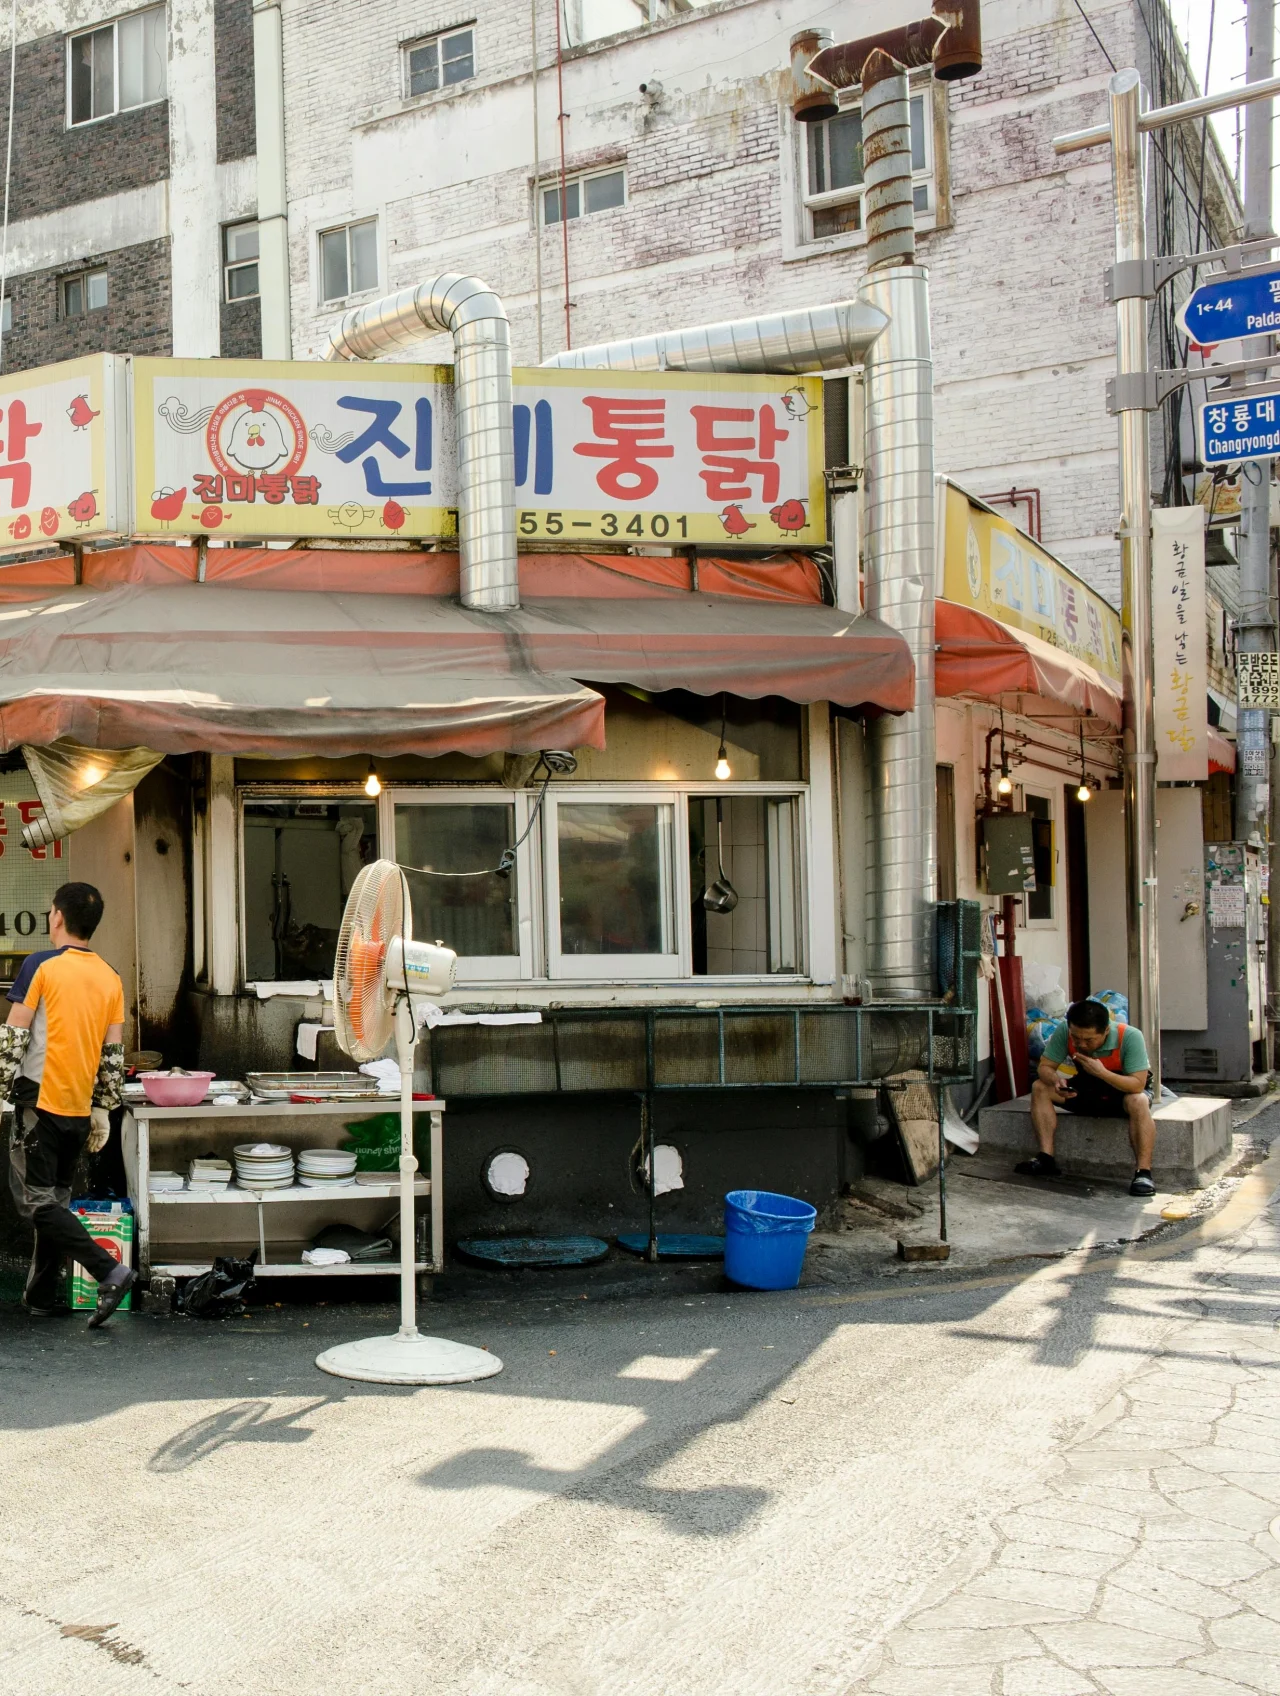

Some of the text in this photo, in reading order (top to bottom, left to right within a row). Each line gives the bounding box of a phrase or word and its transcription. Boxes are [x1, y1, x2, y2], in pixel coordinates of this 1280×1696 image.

[1247, 311, 1280, 329] Palda
[1208, 399, 1280, 434] 창룡대
[192, 474, 323, 505] 진미통닭
[1240, 653, 1278, 673] 못받은돈
